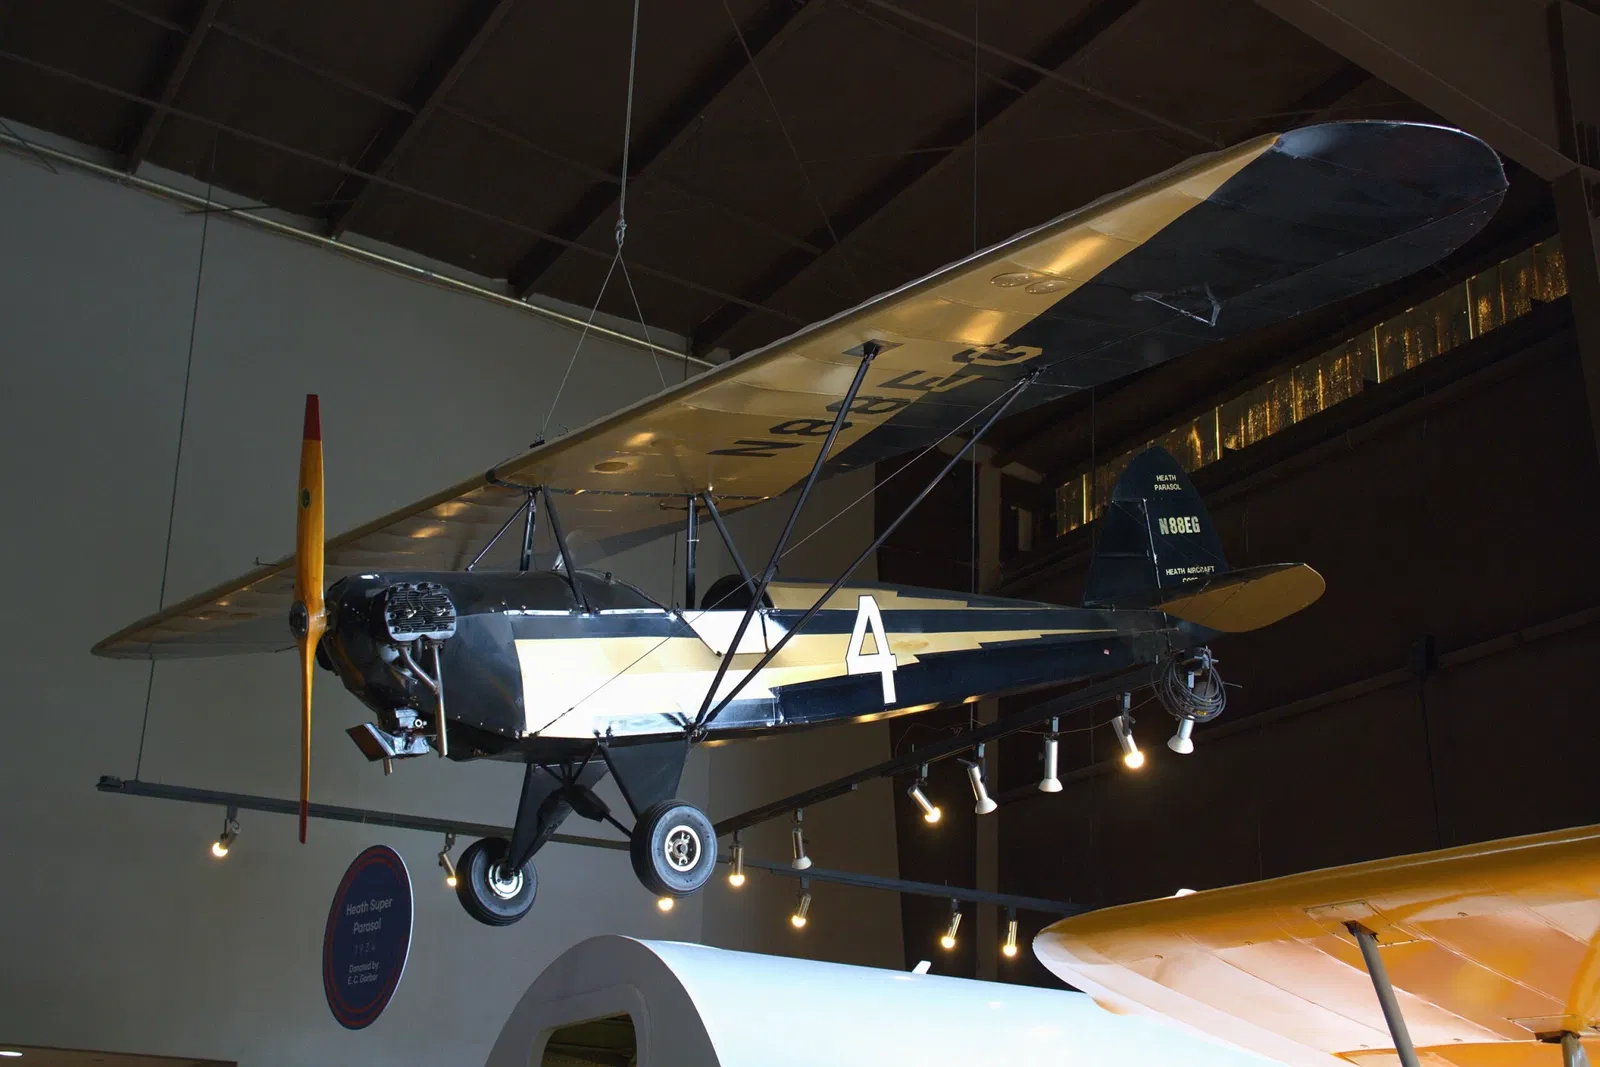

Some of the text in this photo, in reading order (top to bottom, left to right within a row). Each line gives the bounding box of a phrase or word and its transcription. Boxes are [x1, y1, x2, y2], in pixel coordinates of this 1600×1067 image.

[1156, 474, 1177, 482] HEATH
[1154, 483, 1182, 491] PARASOL
[1158, 516, 1201, 535] N88EG
[1165, 565, 1216, 576] HEATH AIRCRAFT
[845, 594, 898, 705] 4
[346, 898, 393, 916] Heath Super
[353, 918, 382, 935] Parasol
[349, 960, 380, 974] Donated by
